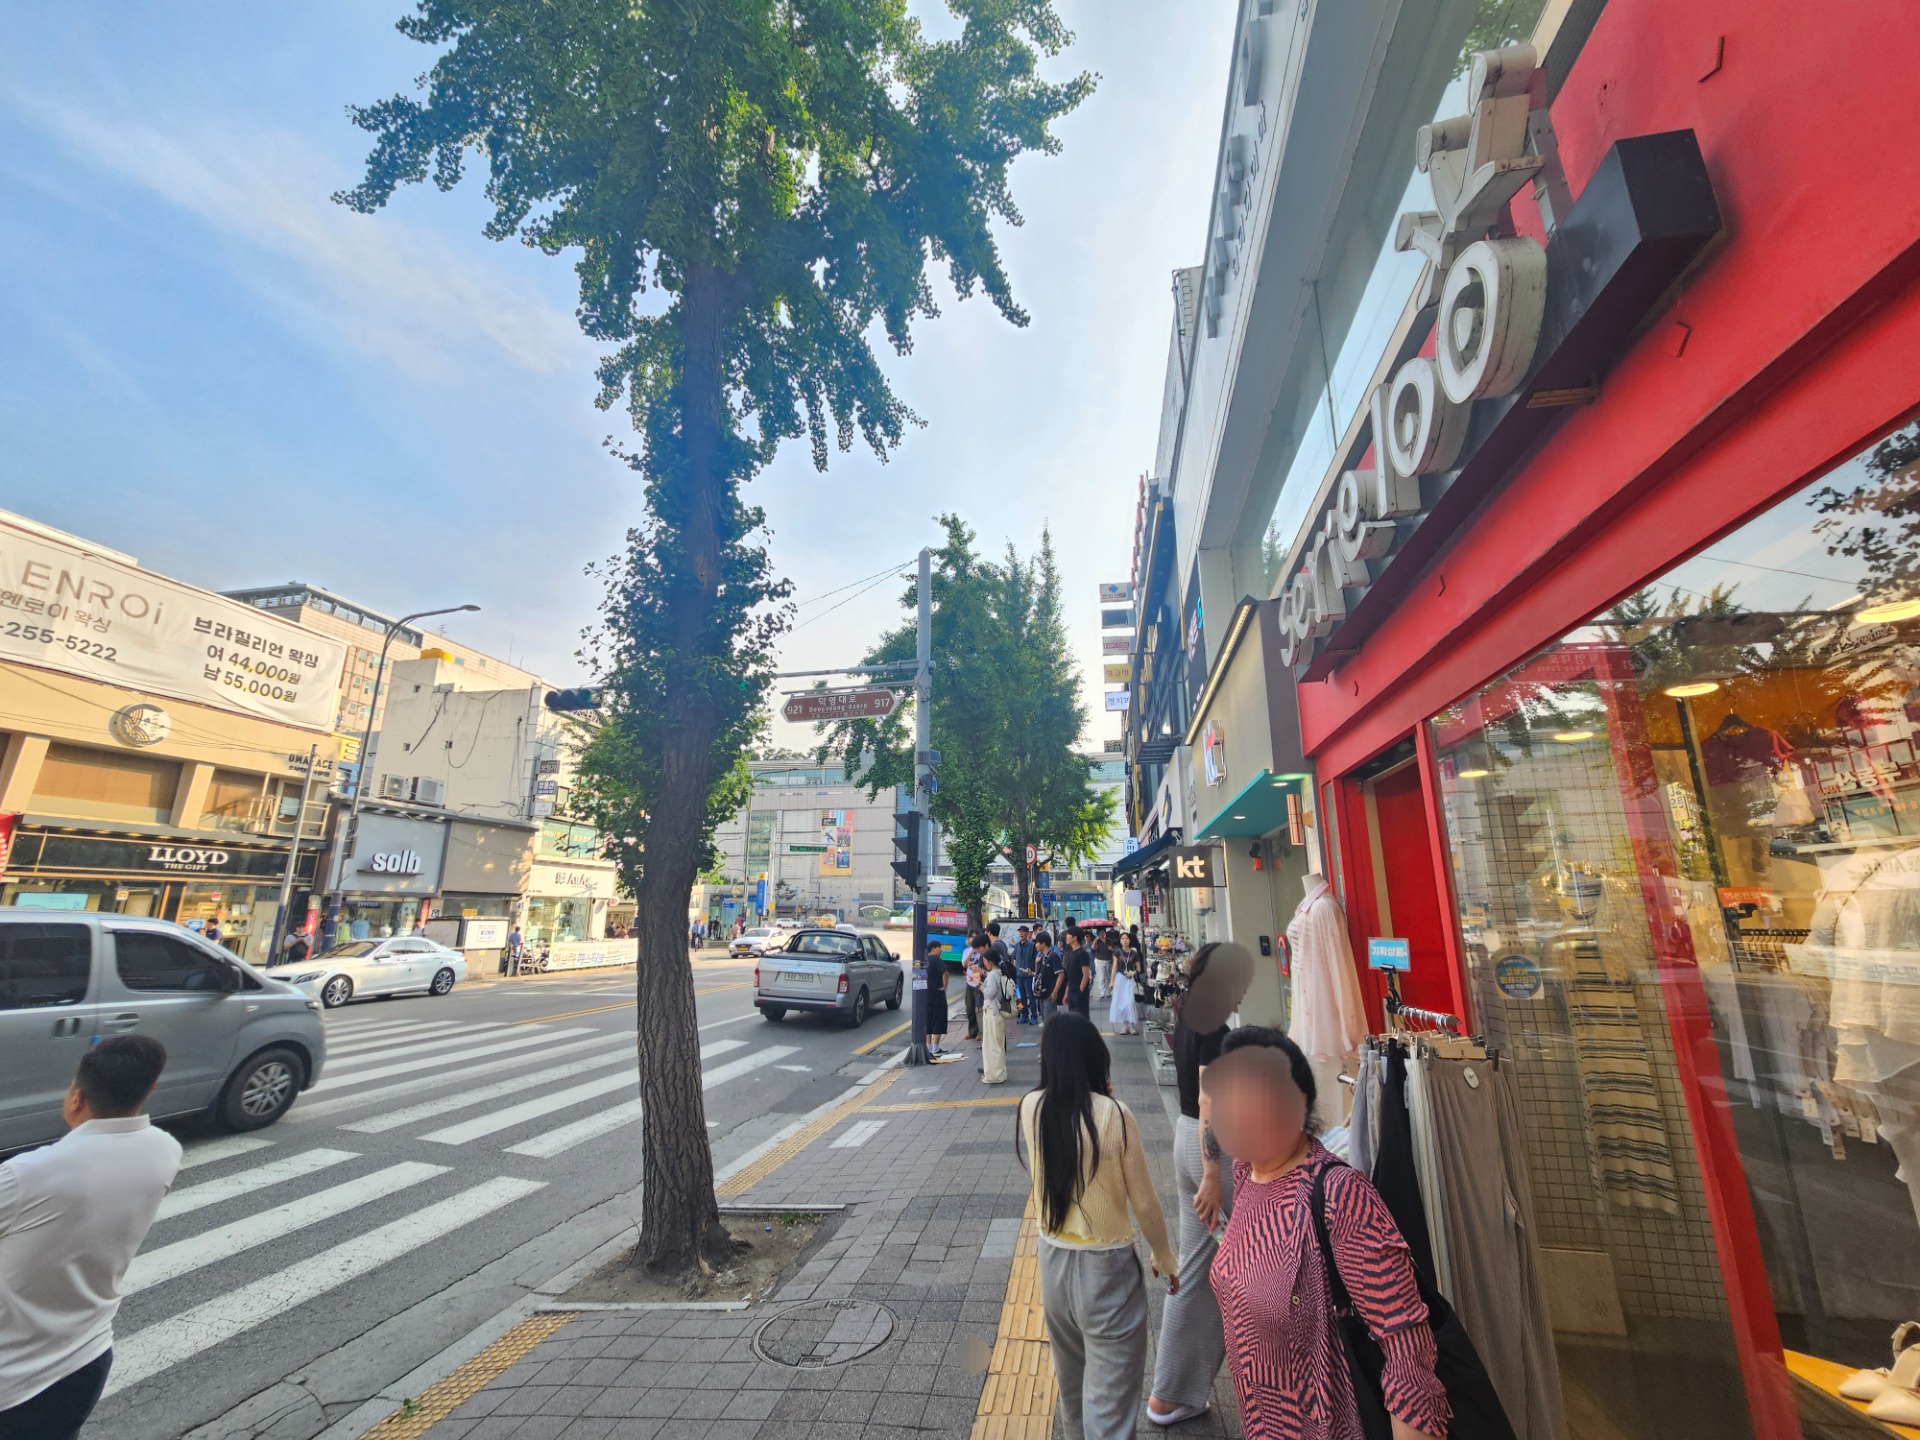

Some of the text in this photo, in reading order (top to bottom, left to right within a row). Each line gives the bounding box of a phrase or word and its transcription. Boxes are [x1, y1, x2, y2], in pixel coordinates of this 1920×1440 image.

[74, 609, 112, 634] 왁싱
[193, 616, 319, 669] 브라질리언 왁싱
[207, 644, 302, 685] 여 44,000원
[203, 663, 298, 703] 남 55,000원
[787, 704, 803, 715] 921
[818, 694, 857, 706] 덕영대로
[874, 698, 890, 709] 917
[288, 753, 334, 770] OMAACE
[148, 846, 229, 865] LLOYD
[371, 849, 421, 874] solb
[1027, 850, 1033, 858] 0
[164, 862, 208, 871] THE GIFT
[1176, 855, 1205, 879] kt
